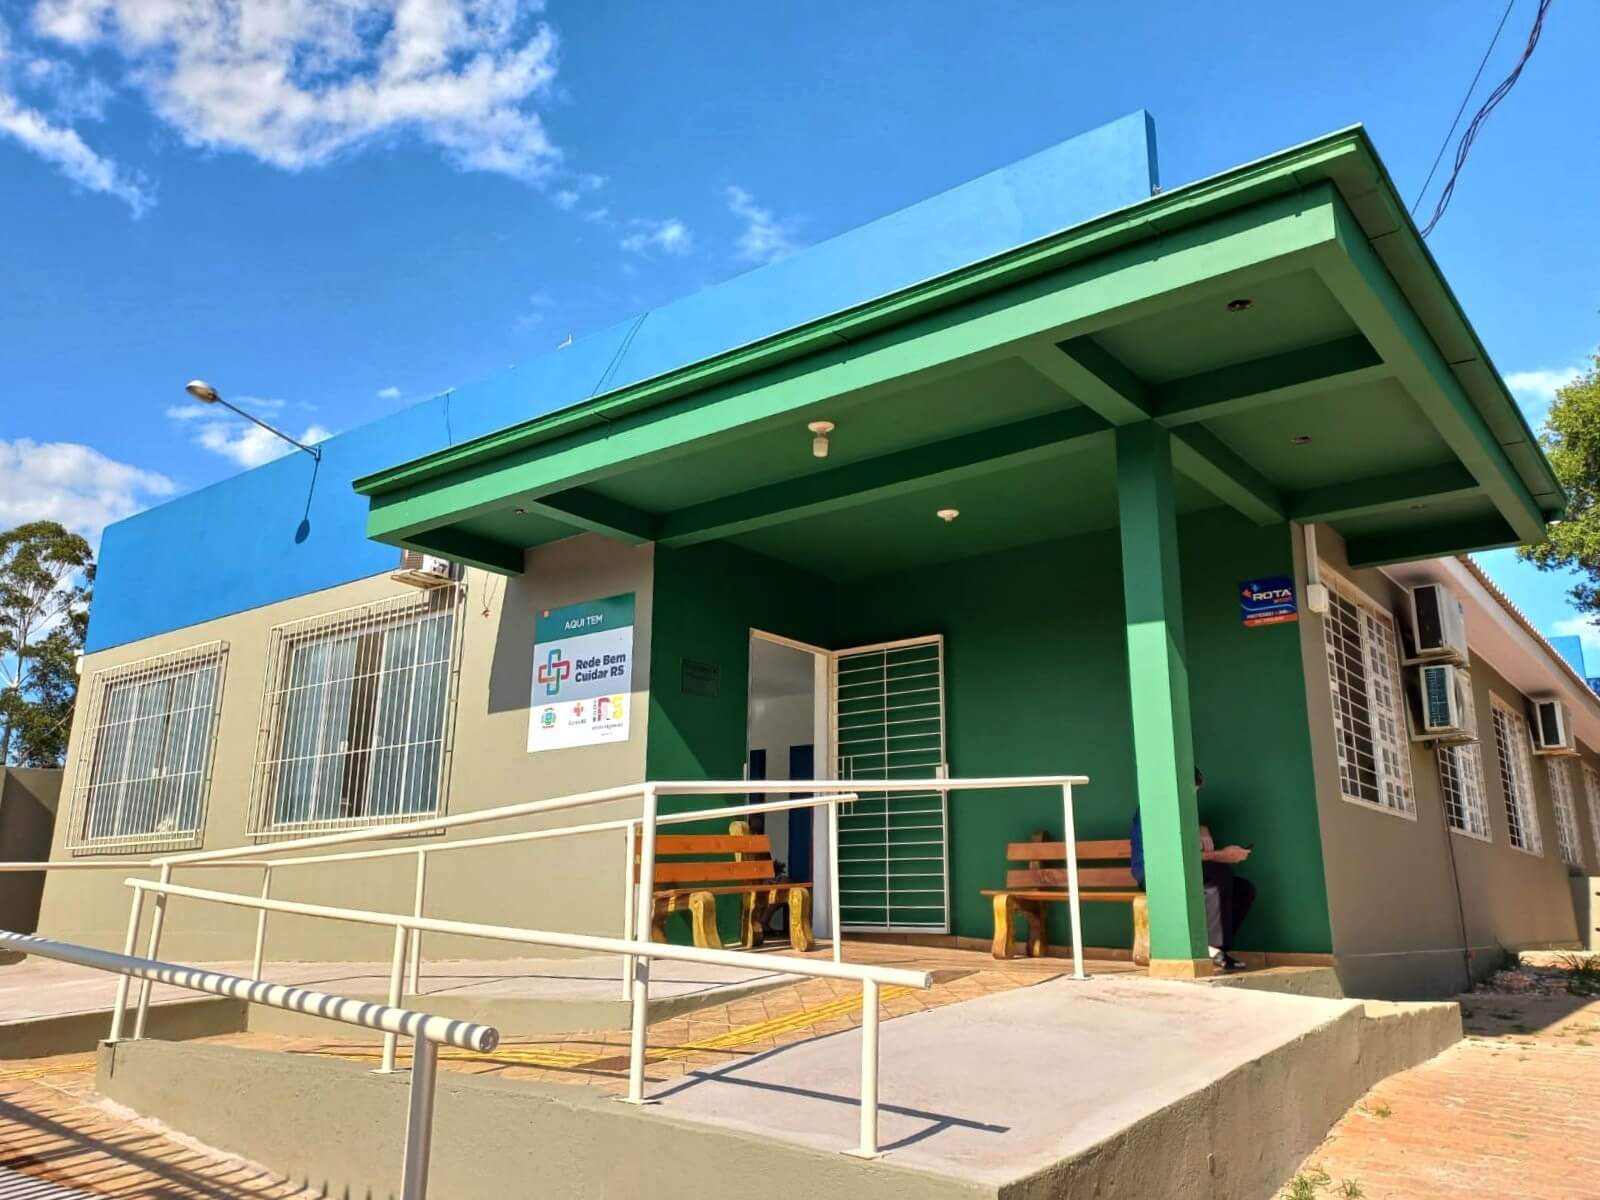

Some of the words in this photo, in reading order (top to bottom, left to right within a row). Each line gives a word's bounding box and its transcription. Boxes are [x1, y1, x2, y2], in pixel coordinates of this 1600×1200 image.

[1252, 588, 1292, 601] ROTA
[565, 618, 585, 631] AQUI
[586, 613, 603, 625] TEM
[575, 657, 601, 670] Rede
[603, 652, 626, 666] Bem
[575, 669, 608, 683] Cuidar
[610, 664, 625, 677] RS
